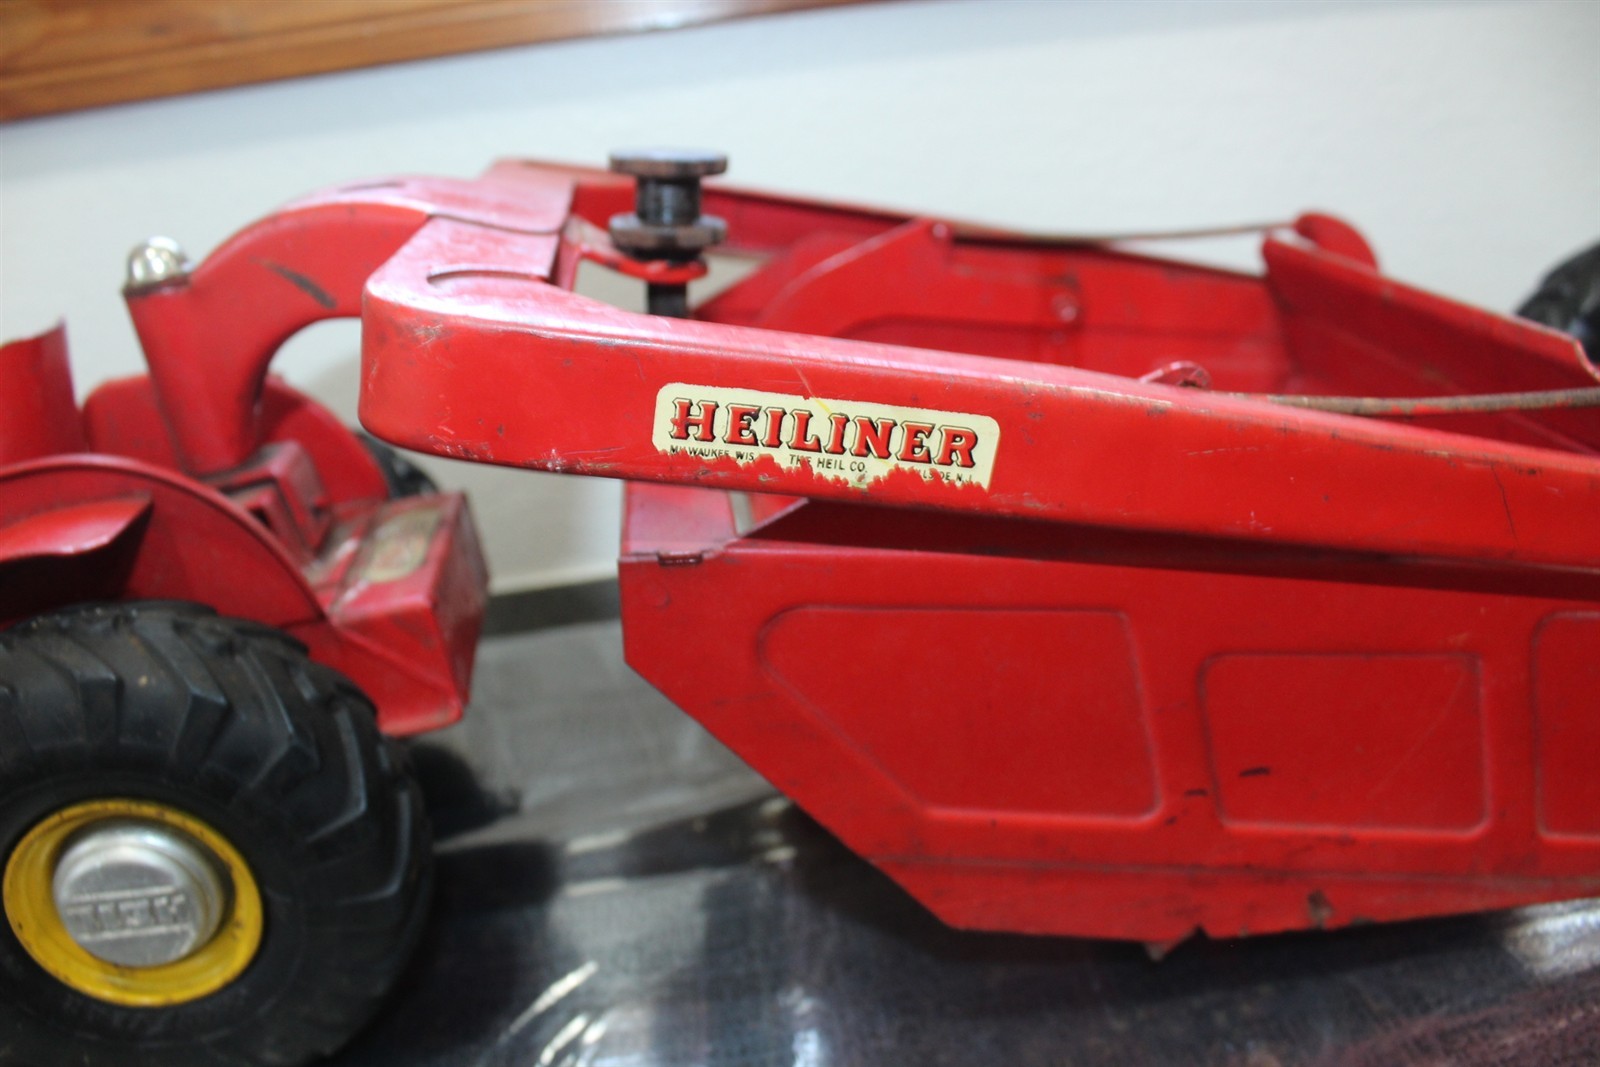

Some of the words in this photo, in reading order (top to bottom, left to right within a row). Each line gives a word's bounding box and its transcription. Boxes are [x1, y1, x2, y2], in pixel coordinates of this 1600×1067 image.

[668, 397, 978, 468] HEILINER
[817, 458, 845, 470] HEIL
[850, 461, 868, 473] CO.
